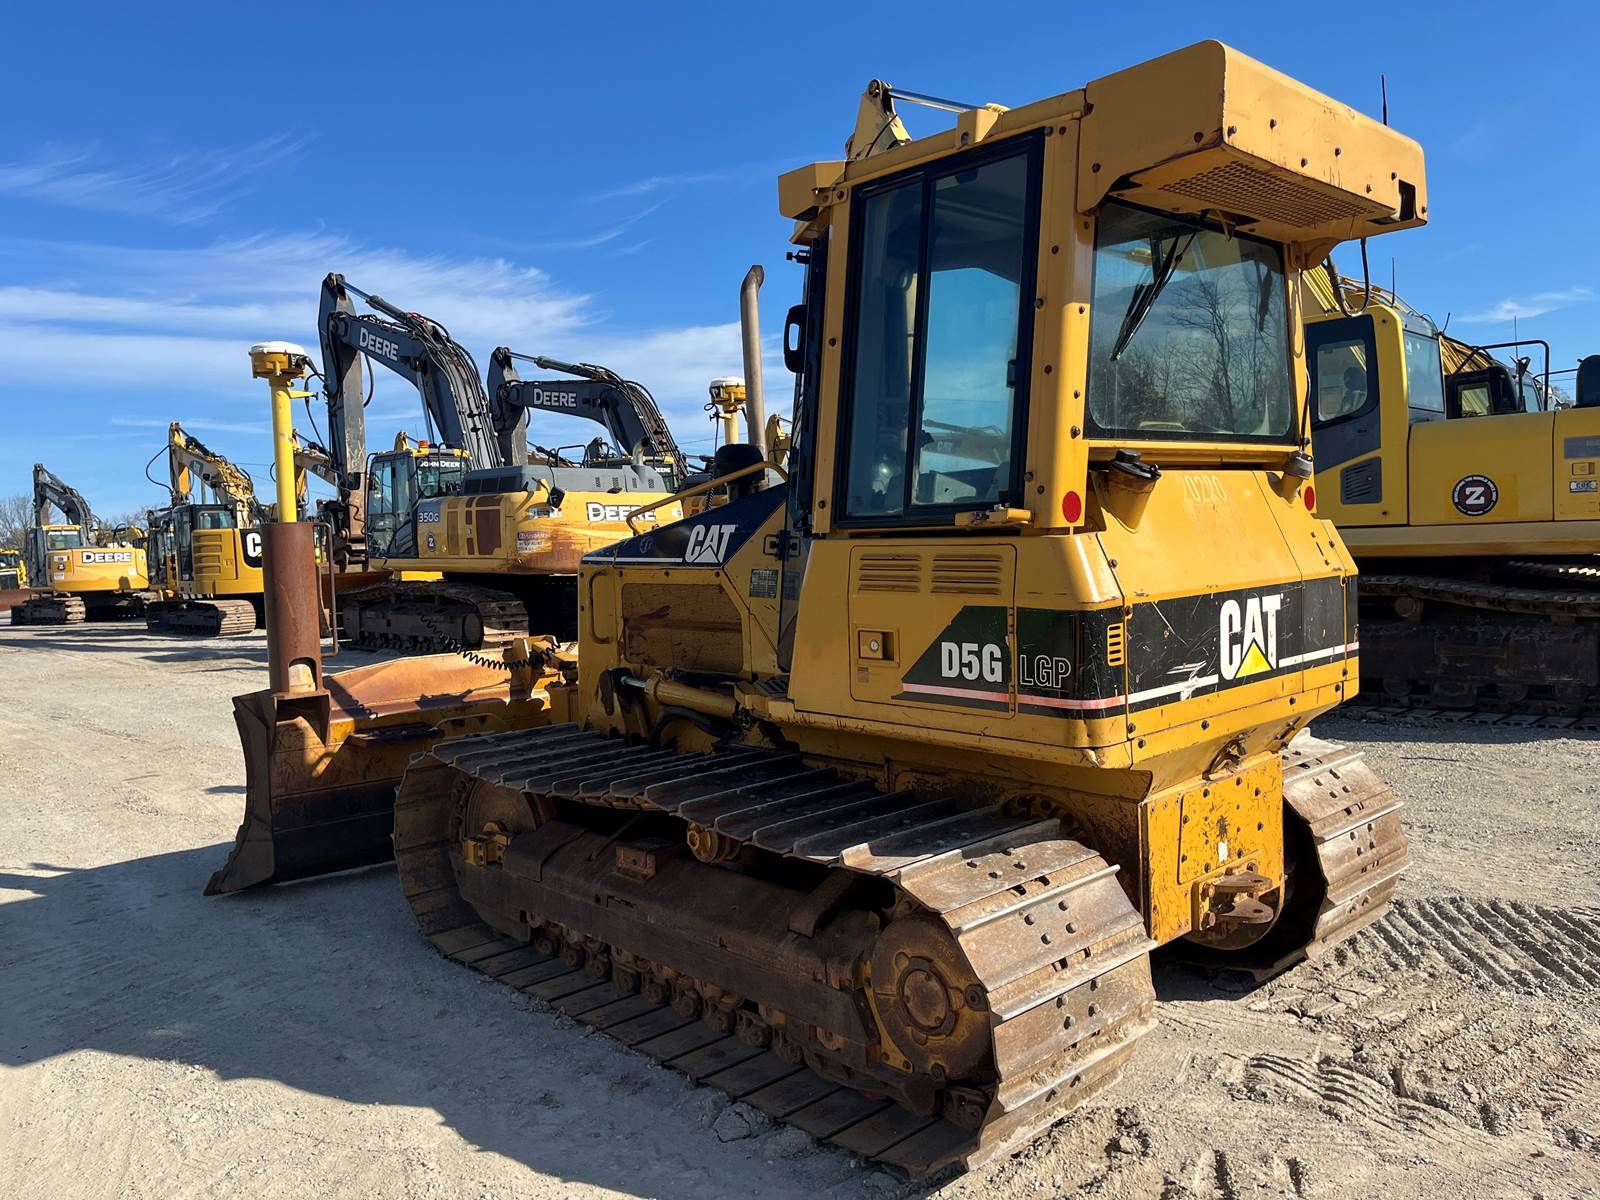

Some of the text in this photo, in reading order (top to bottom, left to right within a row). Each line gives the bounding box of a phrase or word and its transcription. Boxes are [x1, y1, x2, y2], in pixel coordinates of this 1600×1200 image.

[360, 327, 398, 361] DEERE
[533, 388, 577, 407] DEERE
[1465, 487, 1485, 505] Z
[418, 512, 439, 523] 350G
[82, 551, 132, 563] DEERE
[685, 525, 736, 563] CAT
[1220, 594, 1281, 680] CAT
[941, 641, 1072, 688] D5G LGP
